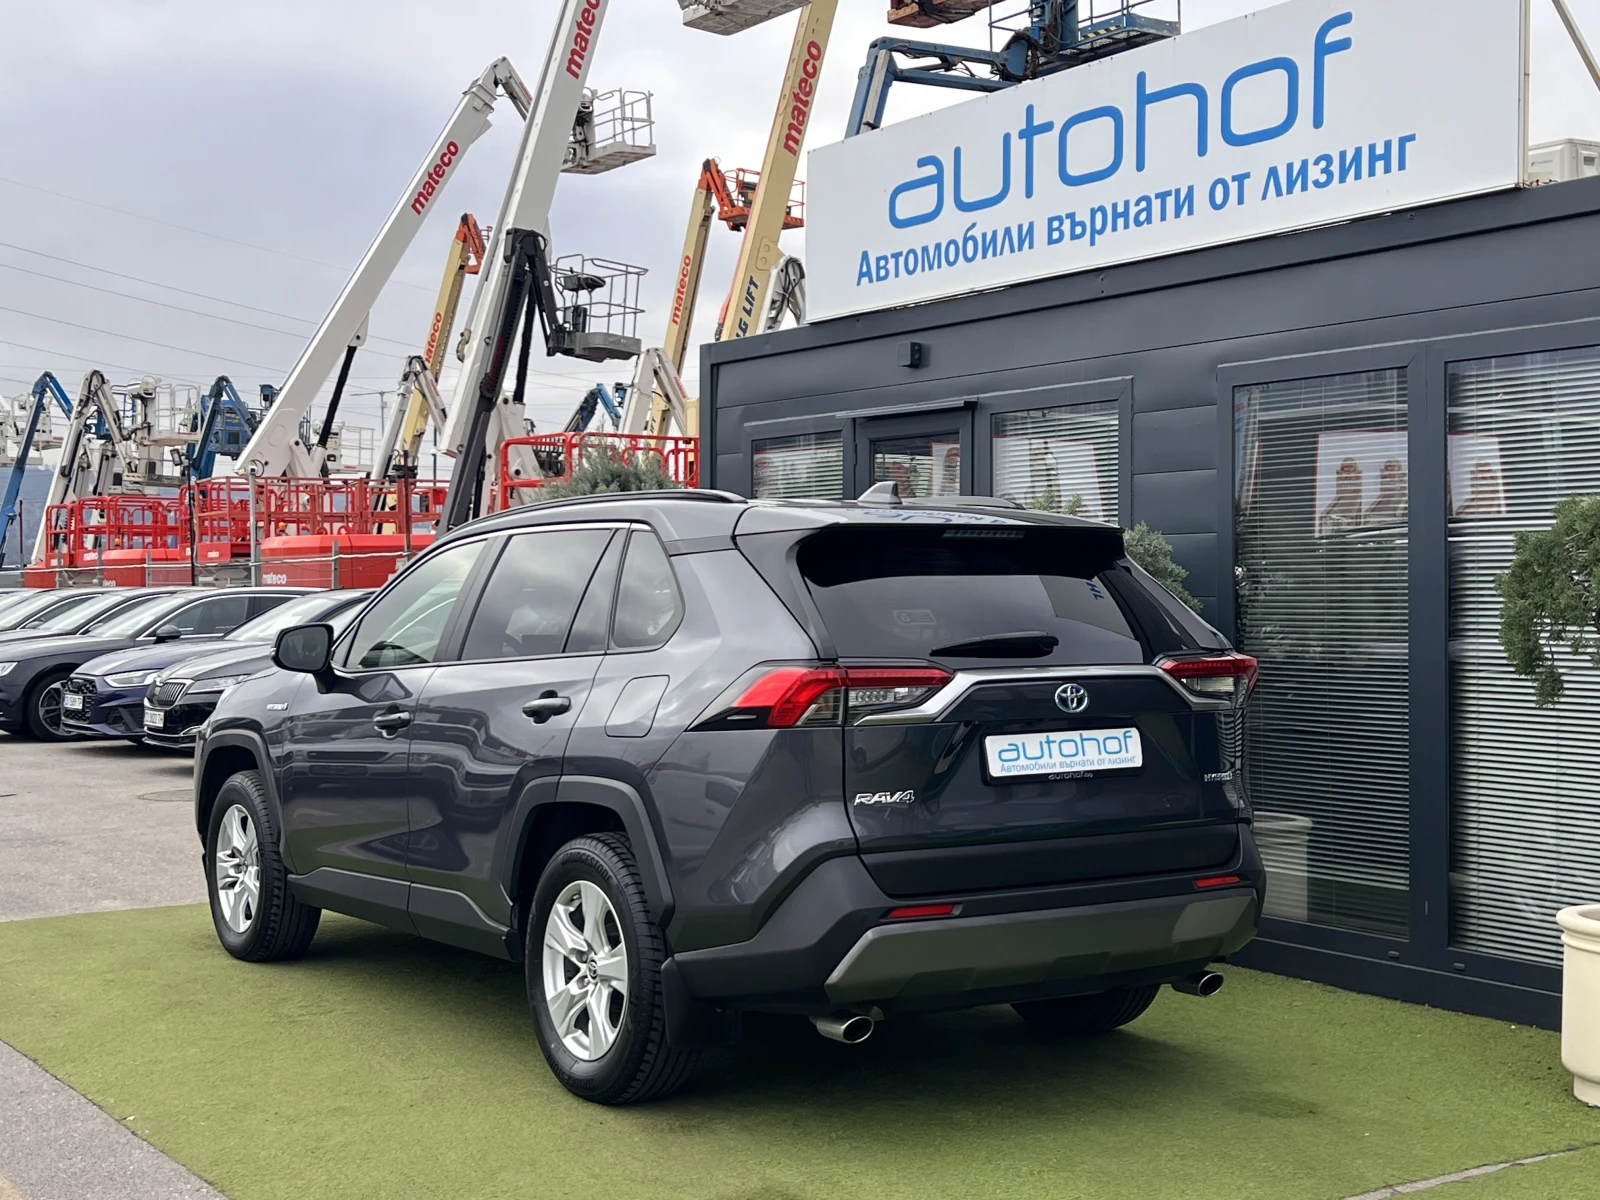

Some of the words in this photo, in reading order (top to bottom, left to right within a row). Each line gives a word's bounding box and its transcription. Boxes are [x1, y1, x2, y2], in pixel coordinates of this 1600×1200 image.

[783, 40, 822, 156] mateco
[889, 12, 1352, 229] autohof
[411, 141, 459, 215] mateco
[856, 222, 1035, 286] Автомобили
[1047, 185, 1195, 247] върнати
[1209, 171, 1251, 211] от
[1261, 133, 1417, 201] лизинг
[671, 255, 691, 326] mateco
[742, 275, 759, 317] LIFT
[997, 729, 1133, 763] autohof
[1000, 761, 1057, 774] Автомобили
[1059, 759, 1095, 771] върнати
[1097, 758, 1106, 767] от
[1107, 756, 1137, 766] лизинг
[854, 789, 915, 806] RAV4
